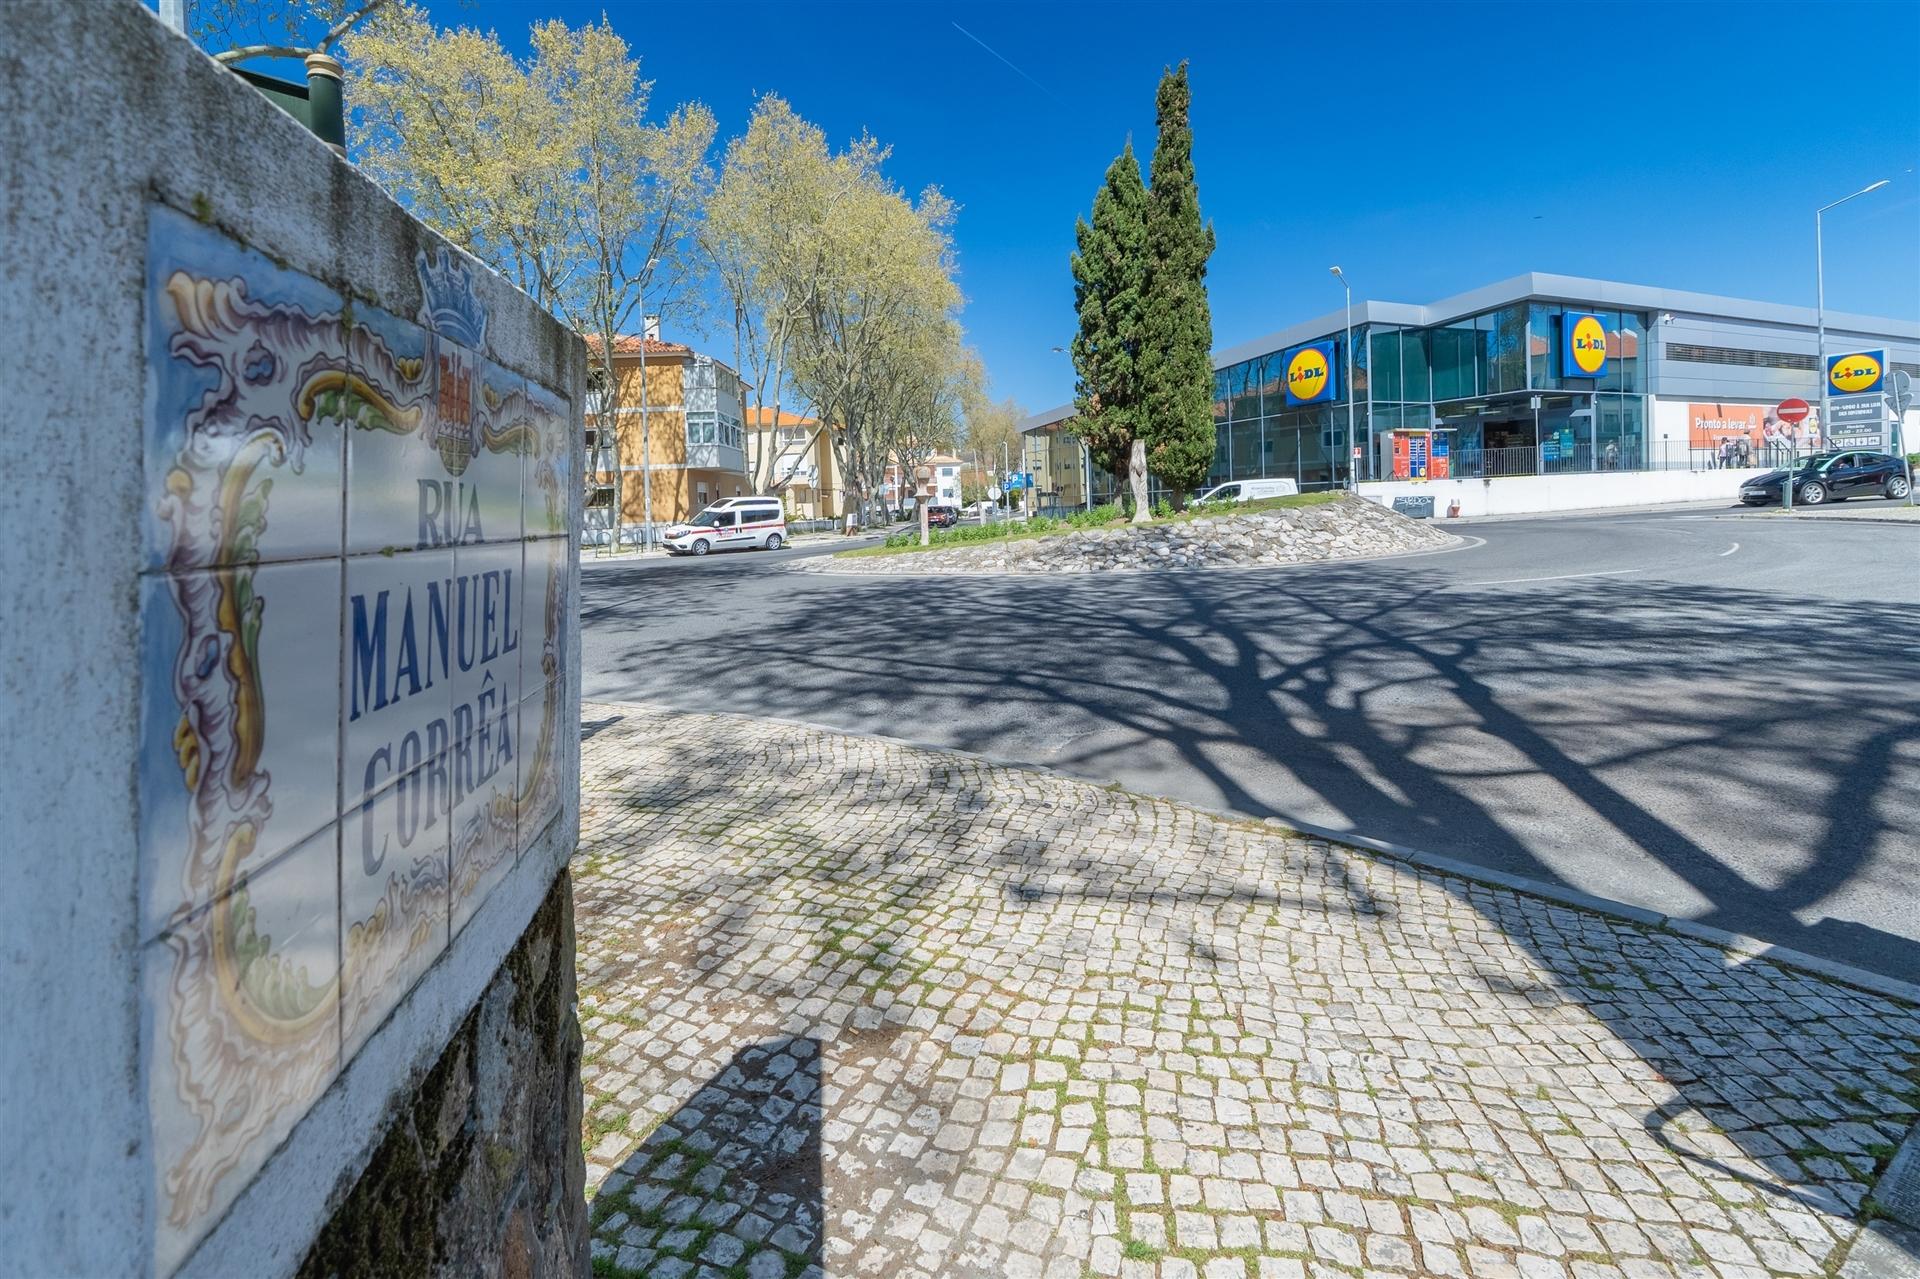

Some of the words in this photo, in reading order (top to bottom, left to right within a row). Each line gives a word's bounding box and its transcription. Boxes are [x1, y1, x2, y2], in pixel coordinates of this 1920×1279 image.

[1695, 417, 1721, 429] Pronto
[1722, 420, 1727, 429] a
[1728, 418, 1746, 429] levar
[416, 479, 485, 550] RUA
[350, 568, 518, 722] MANUEL
[361, 668, 513, 877] CORRÊA
